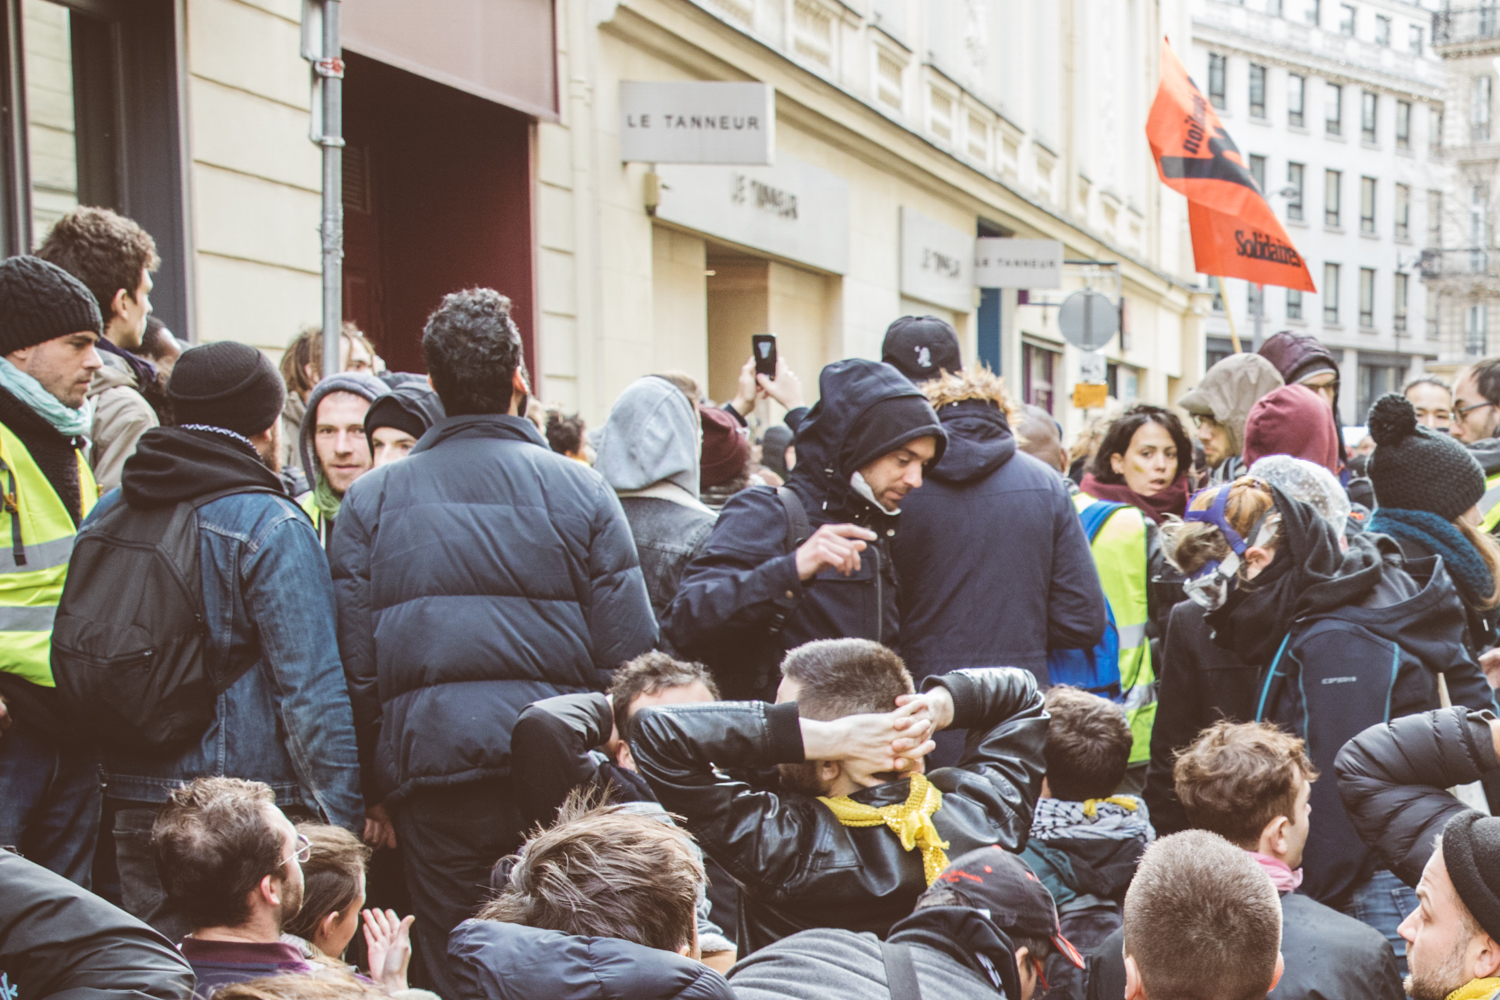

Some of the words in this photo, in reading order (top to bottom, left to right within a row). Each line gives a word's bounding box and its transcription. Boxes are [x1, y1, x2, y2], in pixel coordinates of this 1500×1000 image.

[626, 114, 650, 129] LE
[664, 114, 760, 130] TANNEUR
[1234, 229, 1302, 268] Solidaires
